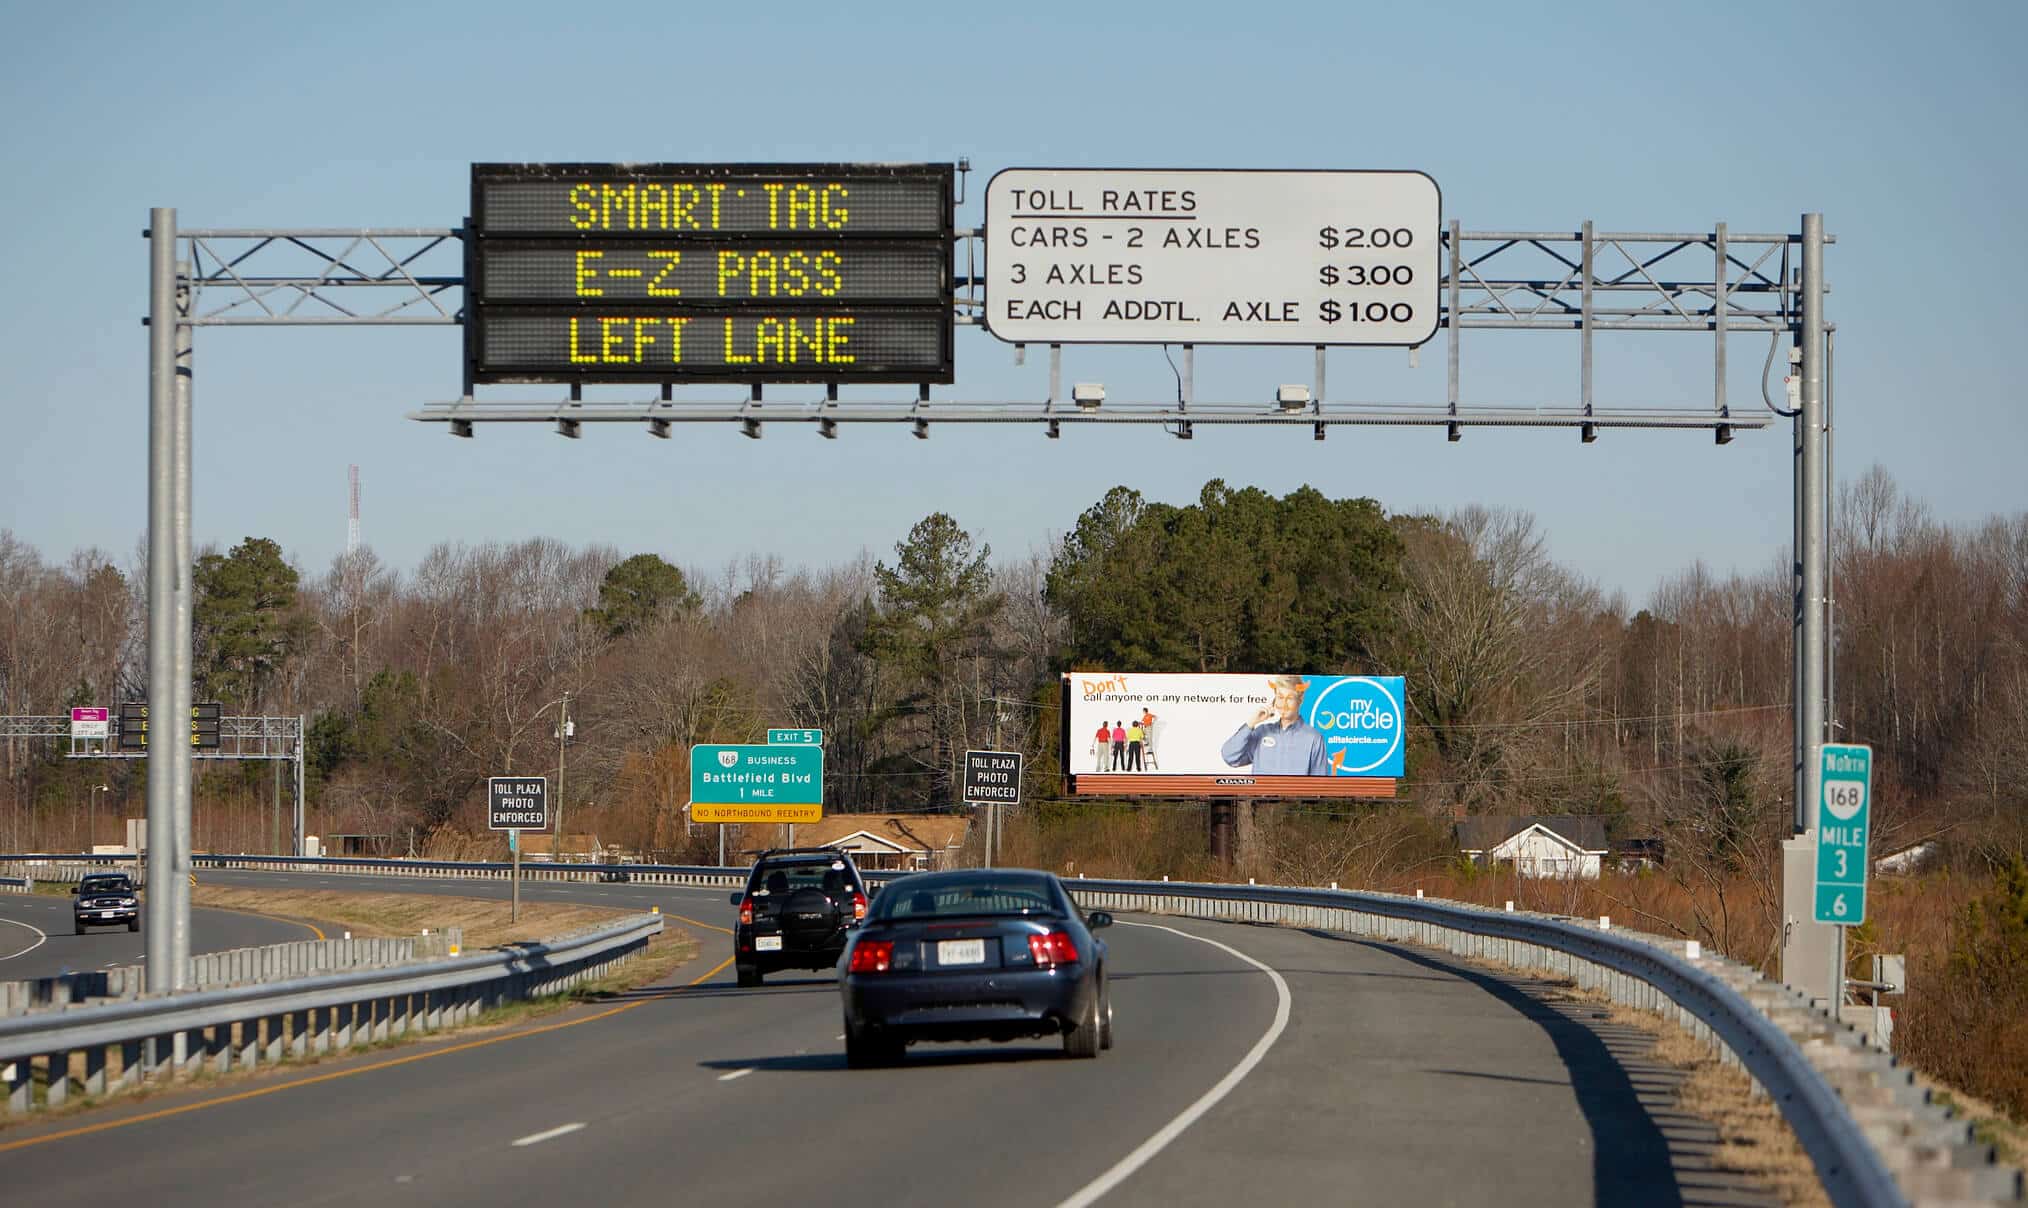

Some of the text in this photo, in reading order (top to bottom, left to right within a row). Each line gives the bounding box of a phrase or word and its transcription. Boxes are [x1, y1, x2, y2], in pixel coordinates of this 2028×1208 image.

[569, 183, 849, 230] SMART TAG
[1011, 190, 1197, 211] TOLL RATES
[1010, 227, 1088, 248] CARS
[1127, 228, 1145, 248] 2
[1163, 228, 1261, 249] AXLES
[1318, 226, 1414, 251] $2.00
[576, 250, 843, 296] E-Z PASS
[1010, 264, 1414, 287] 3 AXLES $3.00
[1007, 300, 1414, 325] EACH ADDTL. AXLE $1.00
[569, 317, 855, 363] LEFT LANE
[1082, 675, 1128, 695] Don't
[1083, 693, 1267, 704] call anyone on any network for free
[1350, 698, 1373, 713] my
[1336, 706, 1394, 729] circle
[777, 731, 813, 742] EXIT 5
[722, 755, 797, 765] 168 BUSINESS
[971, 757, 1016, 770] TOLL PLAZA
[703, 772, 811, 783] Battlefield Blvd
[977, 772, 1008, 783] PHOTO
[494, 783, 541, 794] TOLL PLAZA
[752, 789, 774, 797] MILE
[967, 785, 1016, 798] ENFORCED
[502, 798, 534, 809] PHOTO
[1830, 787, 1859, 807] 168
[493, 812, 543, 823] ENFORCED
[697, 809, 816, 818] NO NORTHBOUND REENTRY
[1821, 826, 1863, 847] MILE
[1833, 849, 1848, 878] 3
